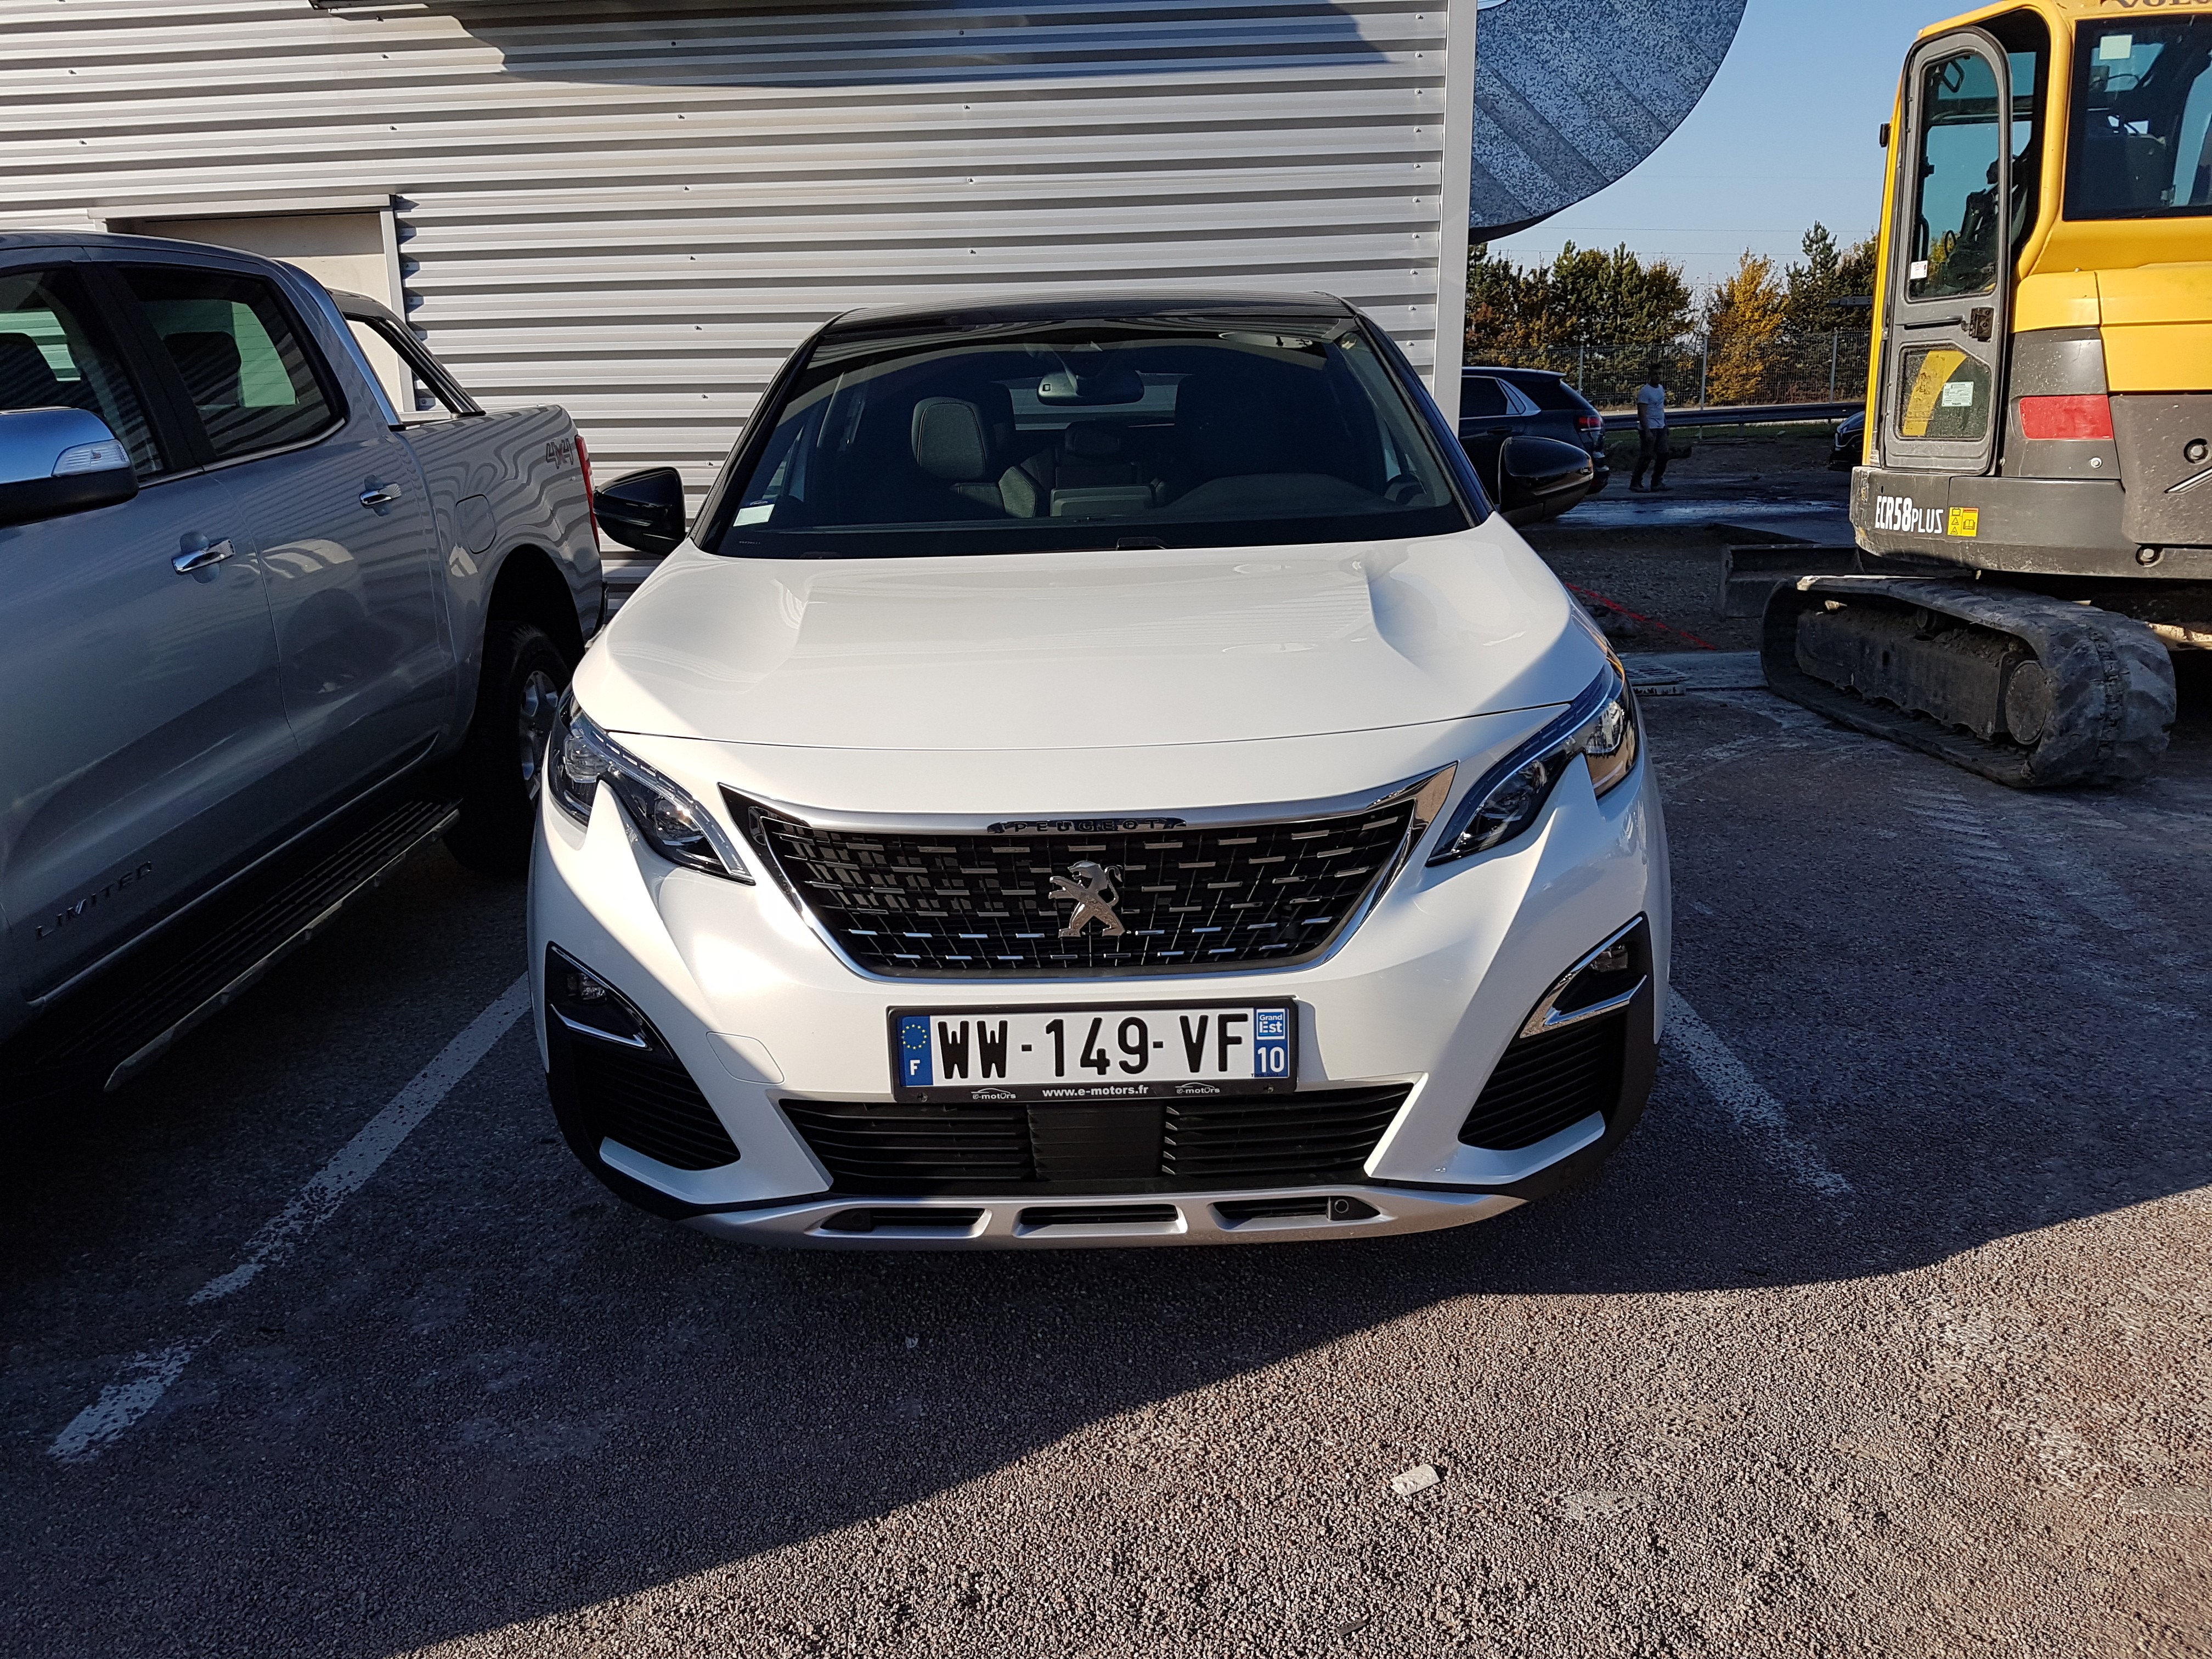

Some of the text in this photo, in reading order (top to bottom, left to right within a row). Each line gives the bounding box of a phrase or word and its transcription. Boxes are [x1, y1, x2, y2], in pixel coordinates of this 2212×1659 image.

[1015, 819, 1159, 832] PEUGEOT
[1260, 1021, 1283, 1033] Est
[1257, 1047, 1284, 1073] 10
[910, 1059, 921, 1076] F
[1042, 1085, 1149, 1097] www.e-motors.fr
